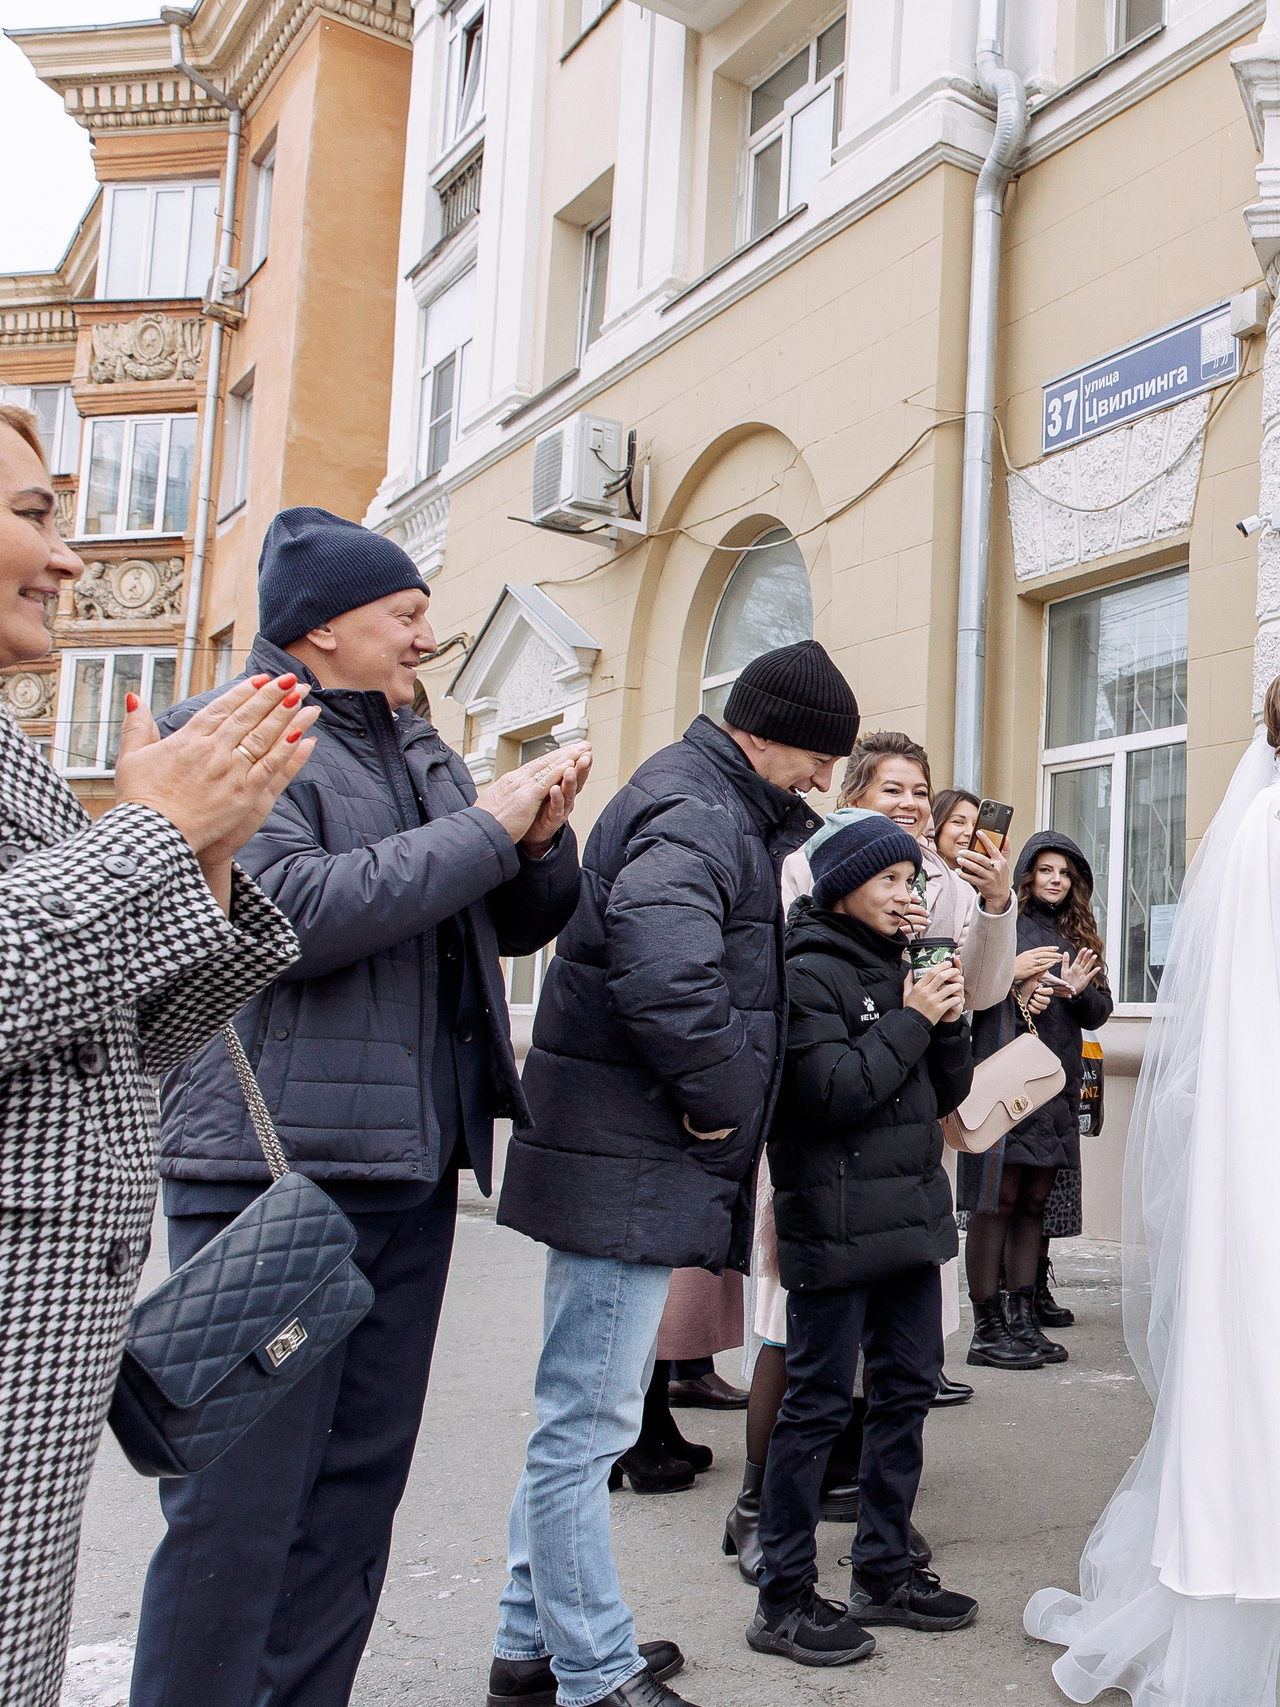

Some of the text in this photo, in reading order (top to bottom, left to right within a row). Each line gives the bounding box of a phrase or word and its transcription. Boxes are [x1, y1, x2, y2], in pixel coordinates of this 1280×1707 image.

[1084, 371, 1119, 399] улица
[1085, 365, 1188, 424] Цвиллинга
[1047, 389, 1078, 437] 37
